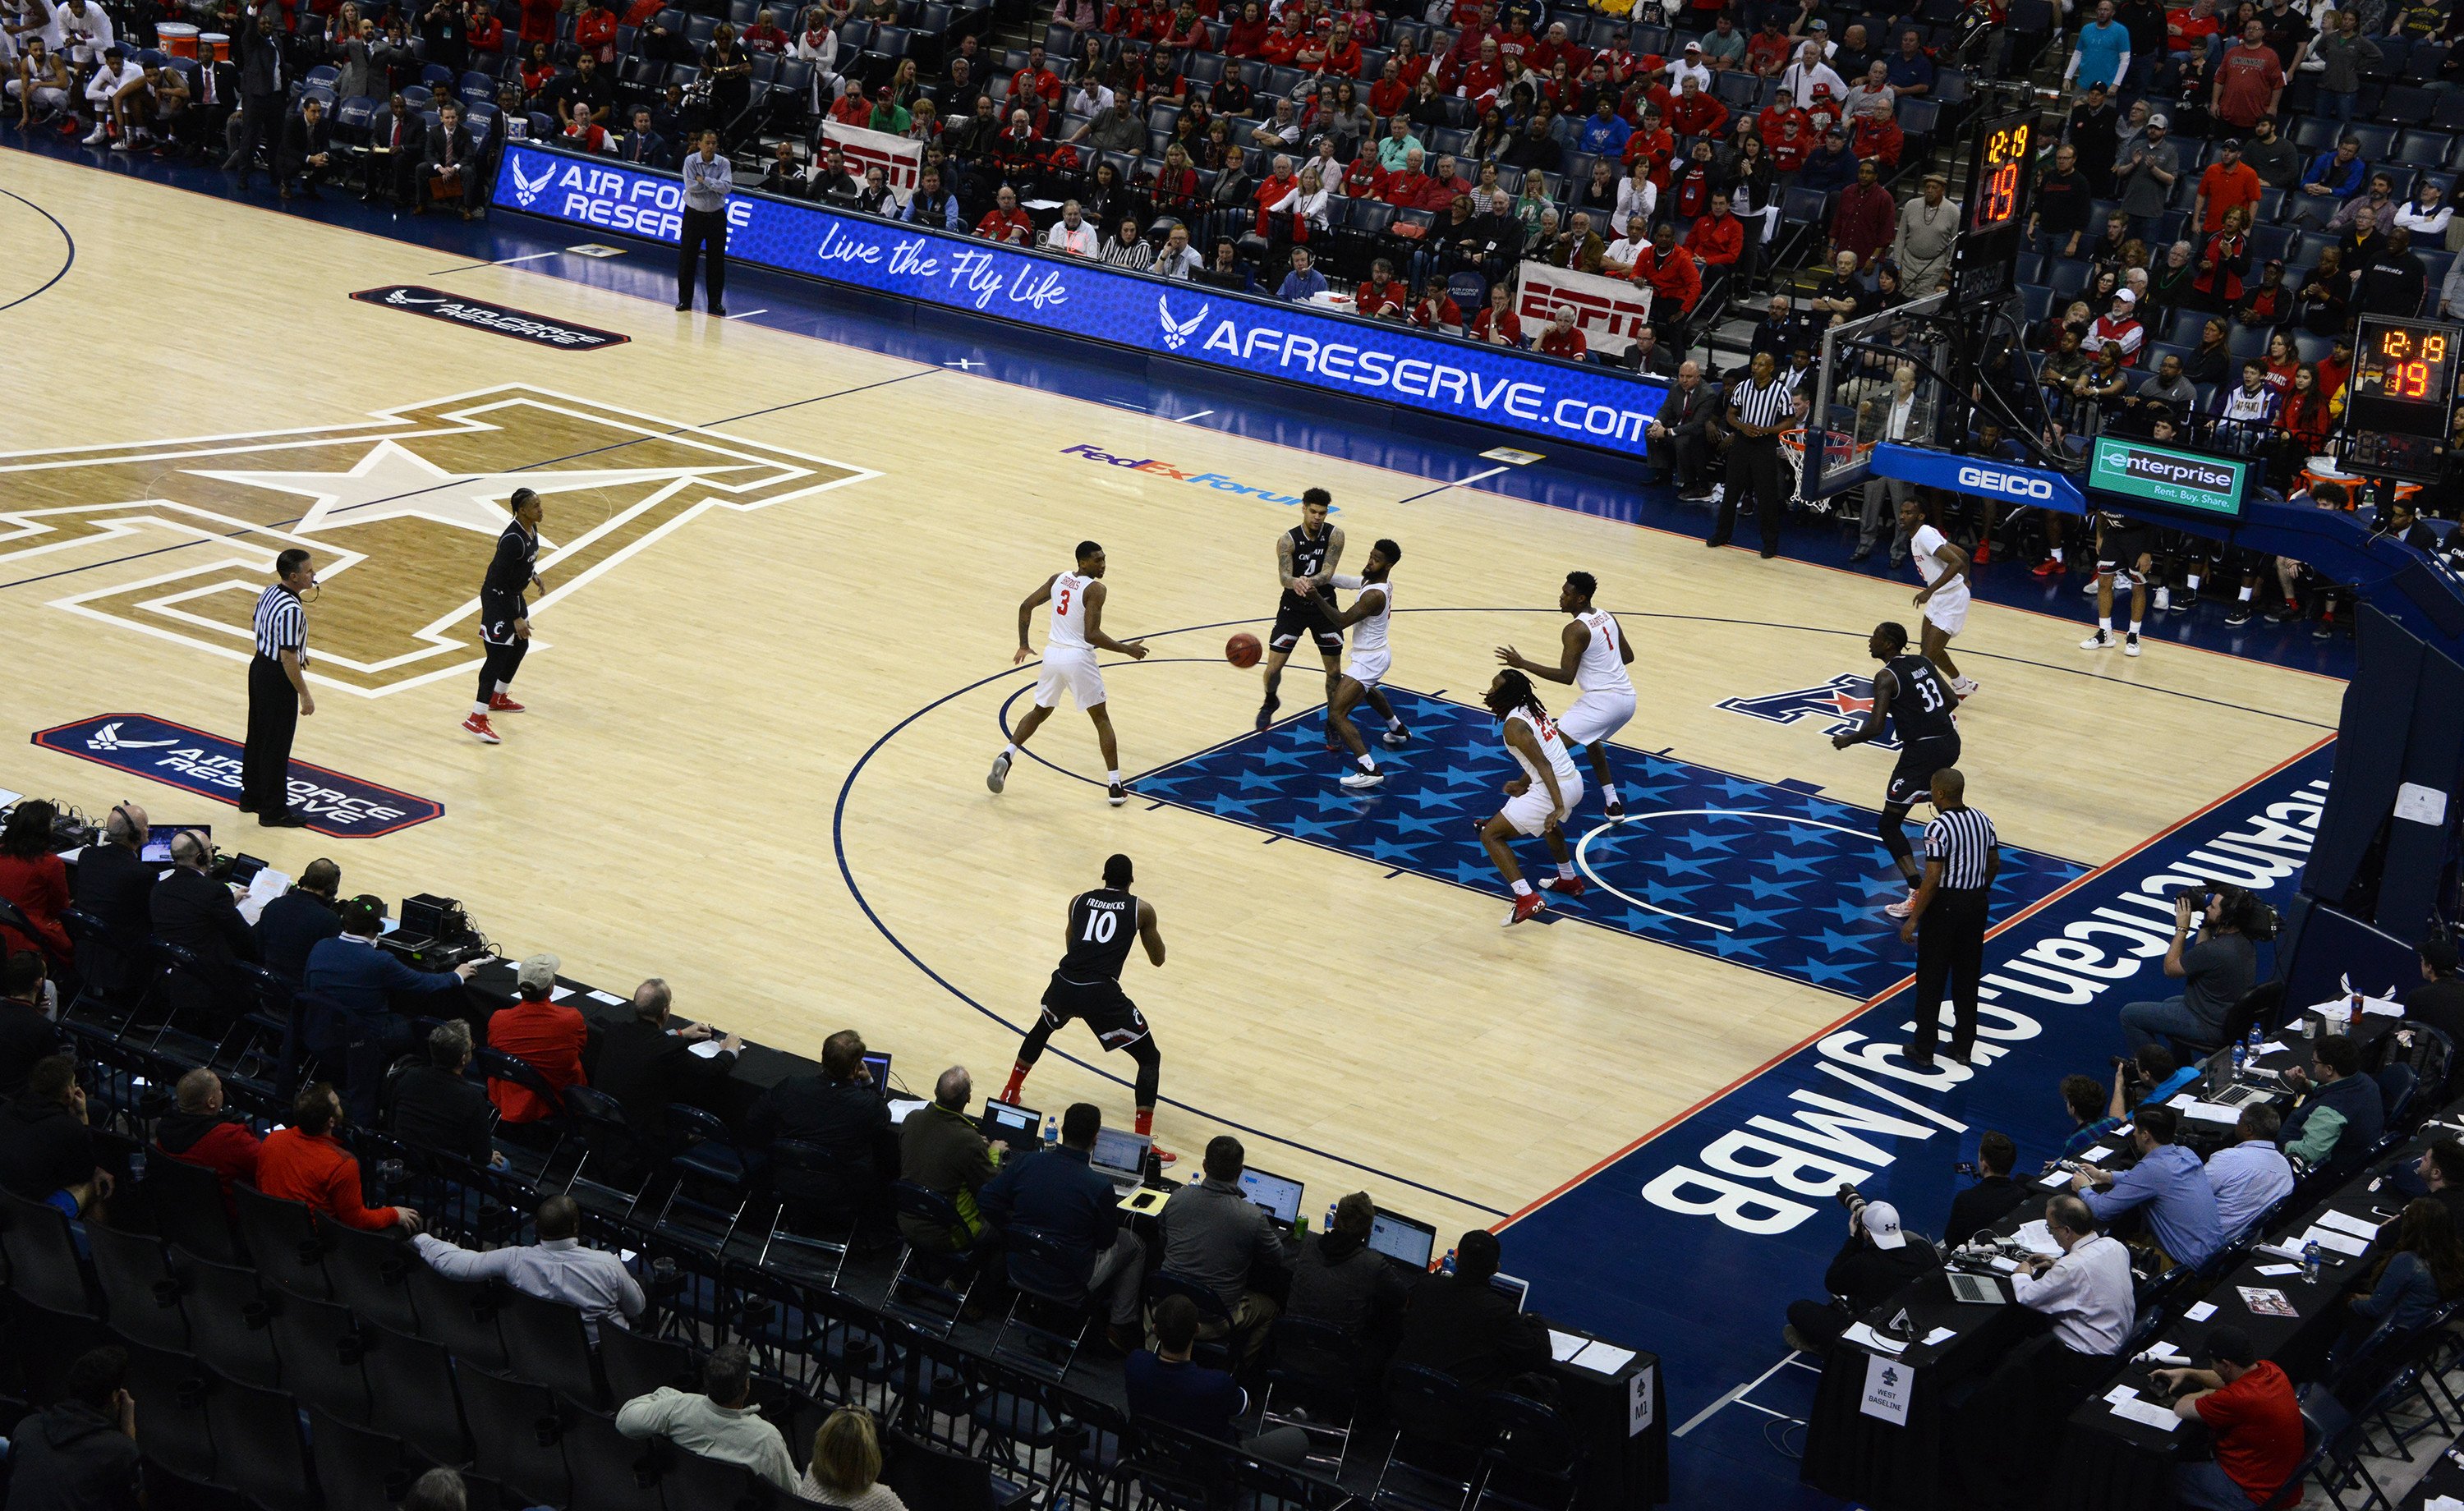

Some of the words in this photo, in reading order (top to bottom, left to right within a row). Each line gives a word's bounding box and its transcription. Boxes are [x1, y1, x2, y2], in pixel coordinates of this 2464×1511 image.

[1988, 125, 2028, 163] 12:19
[816, 137, 918, 190] ESPN
[559, 165, 625, 200] AIR
[630, 180, 753, 227] FOE
[1988, 163, 2017, 221] 19
[563, 193, 733, 251] RESER
[818, 222, 882, 264] Live
[889, 238, 941, 276] the
[949, 250, 1002, 310] Fly
[1009, 264, 1069, 310] Life
[434, 307, 580, 345] RESERVE
[440, 304, 499, 319] AIR
[500, 317, 606, 344] FORCE
[1520, 281, 1645, 338] ESPN
[2384, 331, 2445, 363] 12:19
[2395, 362, 2429, 397] 19
[1958, 466, 2053, 499] GEICO
[2108, 452, 2232, 487] enterprise
[2154, 485, 2177, 498] Rent.
[2180, 490, 2199, 503] Buy.
[2201, 494, 2230, 507] Share.
[1060, 576, 1081, 590] BROOKS
[1057, 590, 1071, 617] 3
[1602, 627, 1614, 651] 1
[1916, 677, 1944, 713] 33
[1535, 711, 1559, 742] 23
[155, 756, 366, 824] RESRVE
[166, 748, 244, 774] AIR
[286, 776, 407, 821] ORCE
[1086, 898, 1125, 911] FREDERICKS
[1082, 909, 1118, 944] 10
[1868, 1394, 1902, 1412] BASELINE
[1877, 1388, 1896, 1399] WEST
